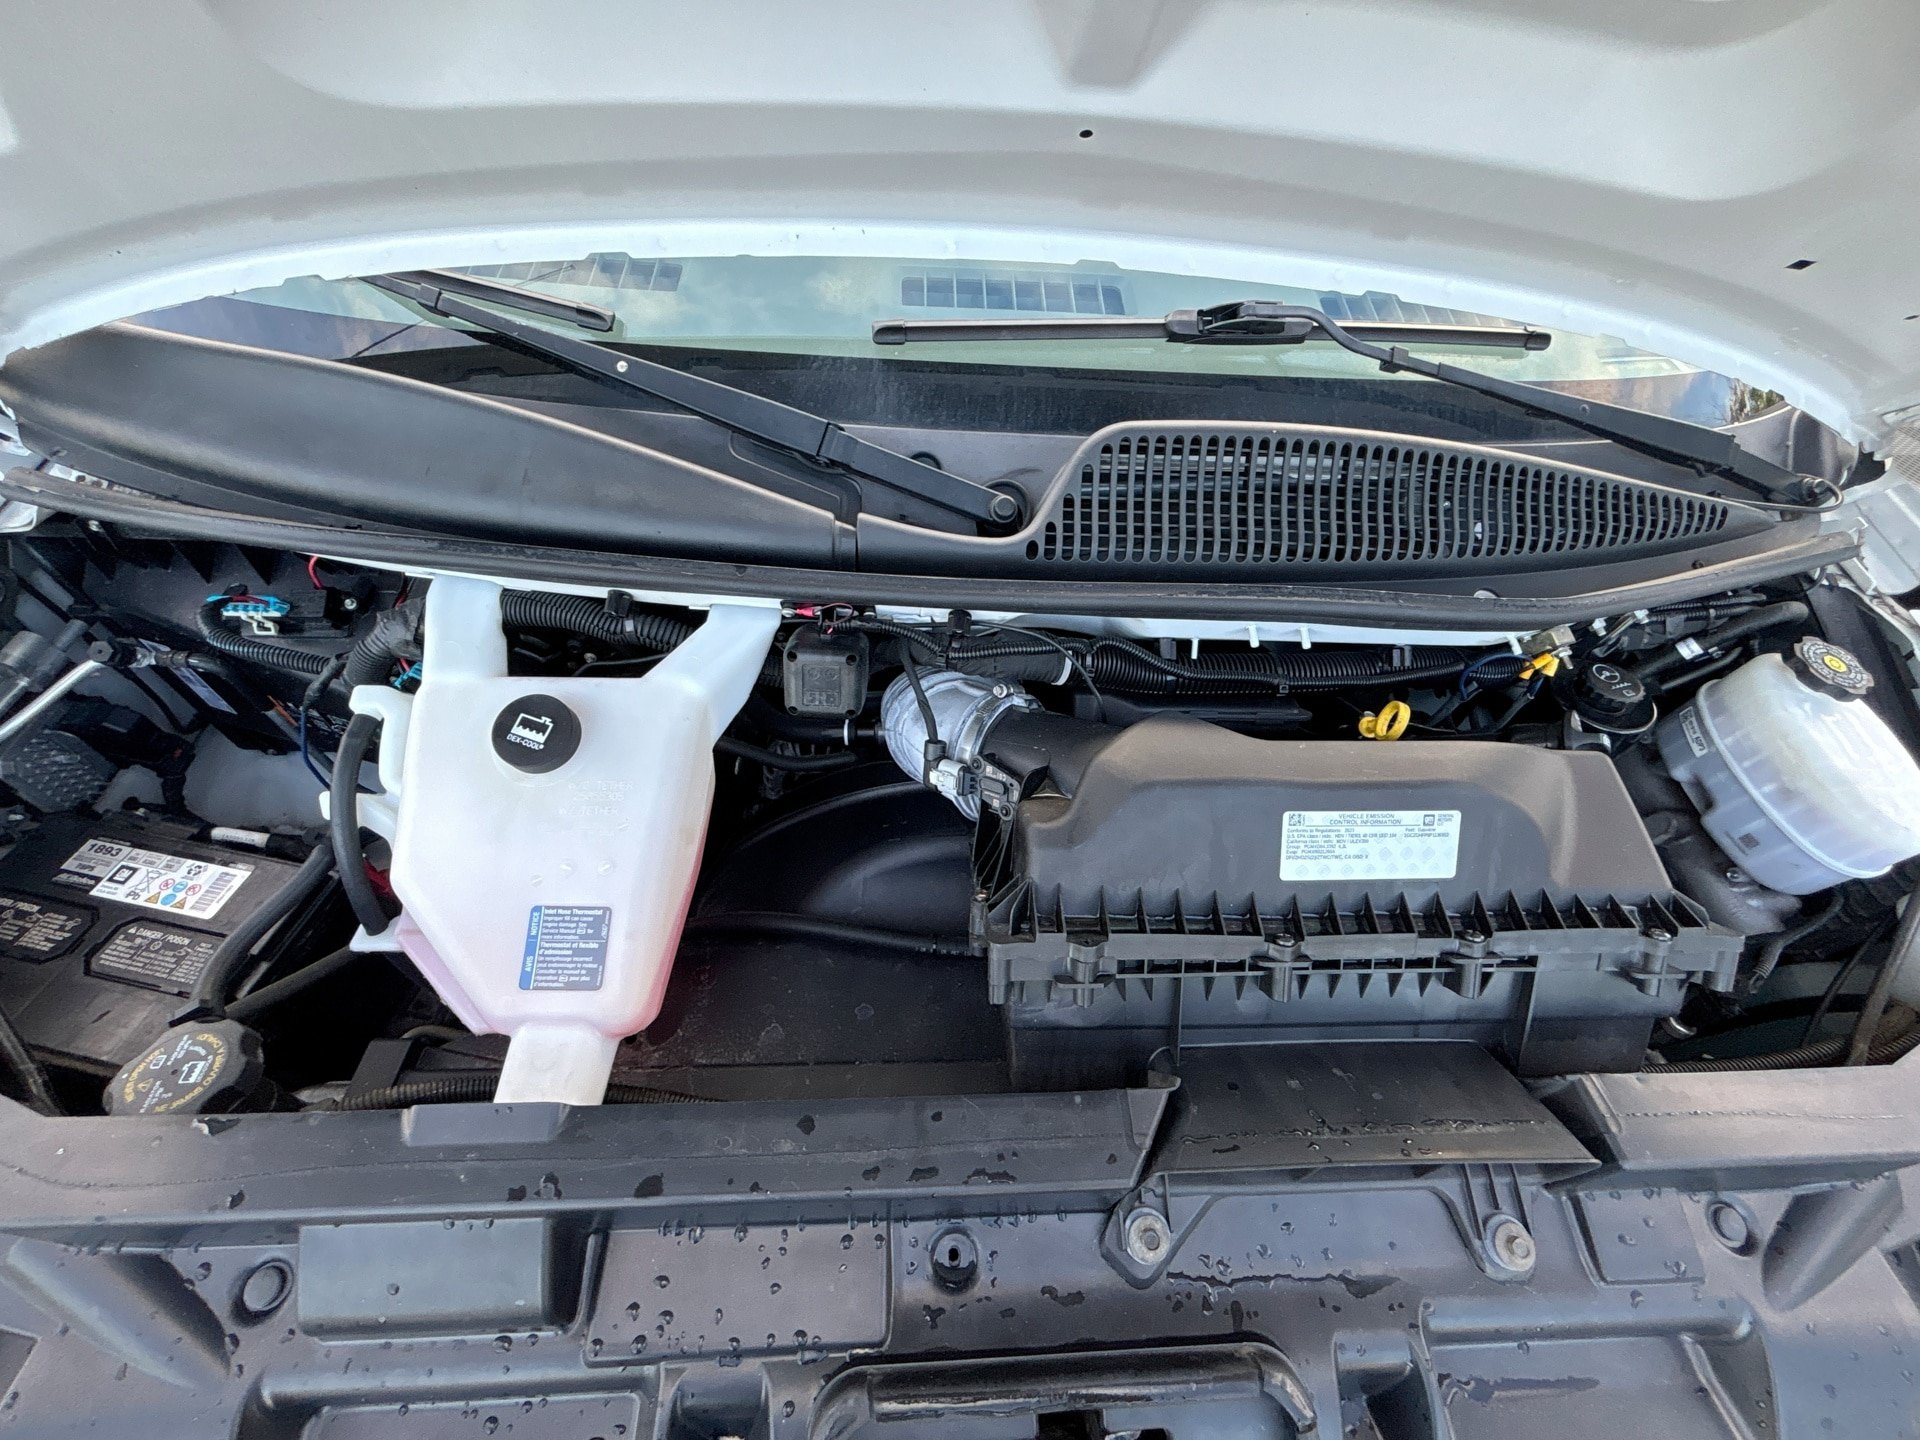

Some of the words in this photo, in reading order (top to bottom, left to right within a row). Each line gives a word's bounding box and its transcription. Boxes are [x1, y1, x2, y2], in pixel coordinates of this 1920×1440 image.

[87, 843, 123, 857] 1893
[125, 890, 141, 901] Pb
[530, 912, 540, 935] NOTICE
[525, 955, 534, 972] AVIS
[203, 1055, 225, 1086] OUVRIR
